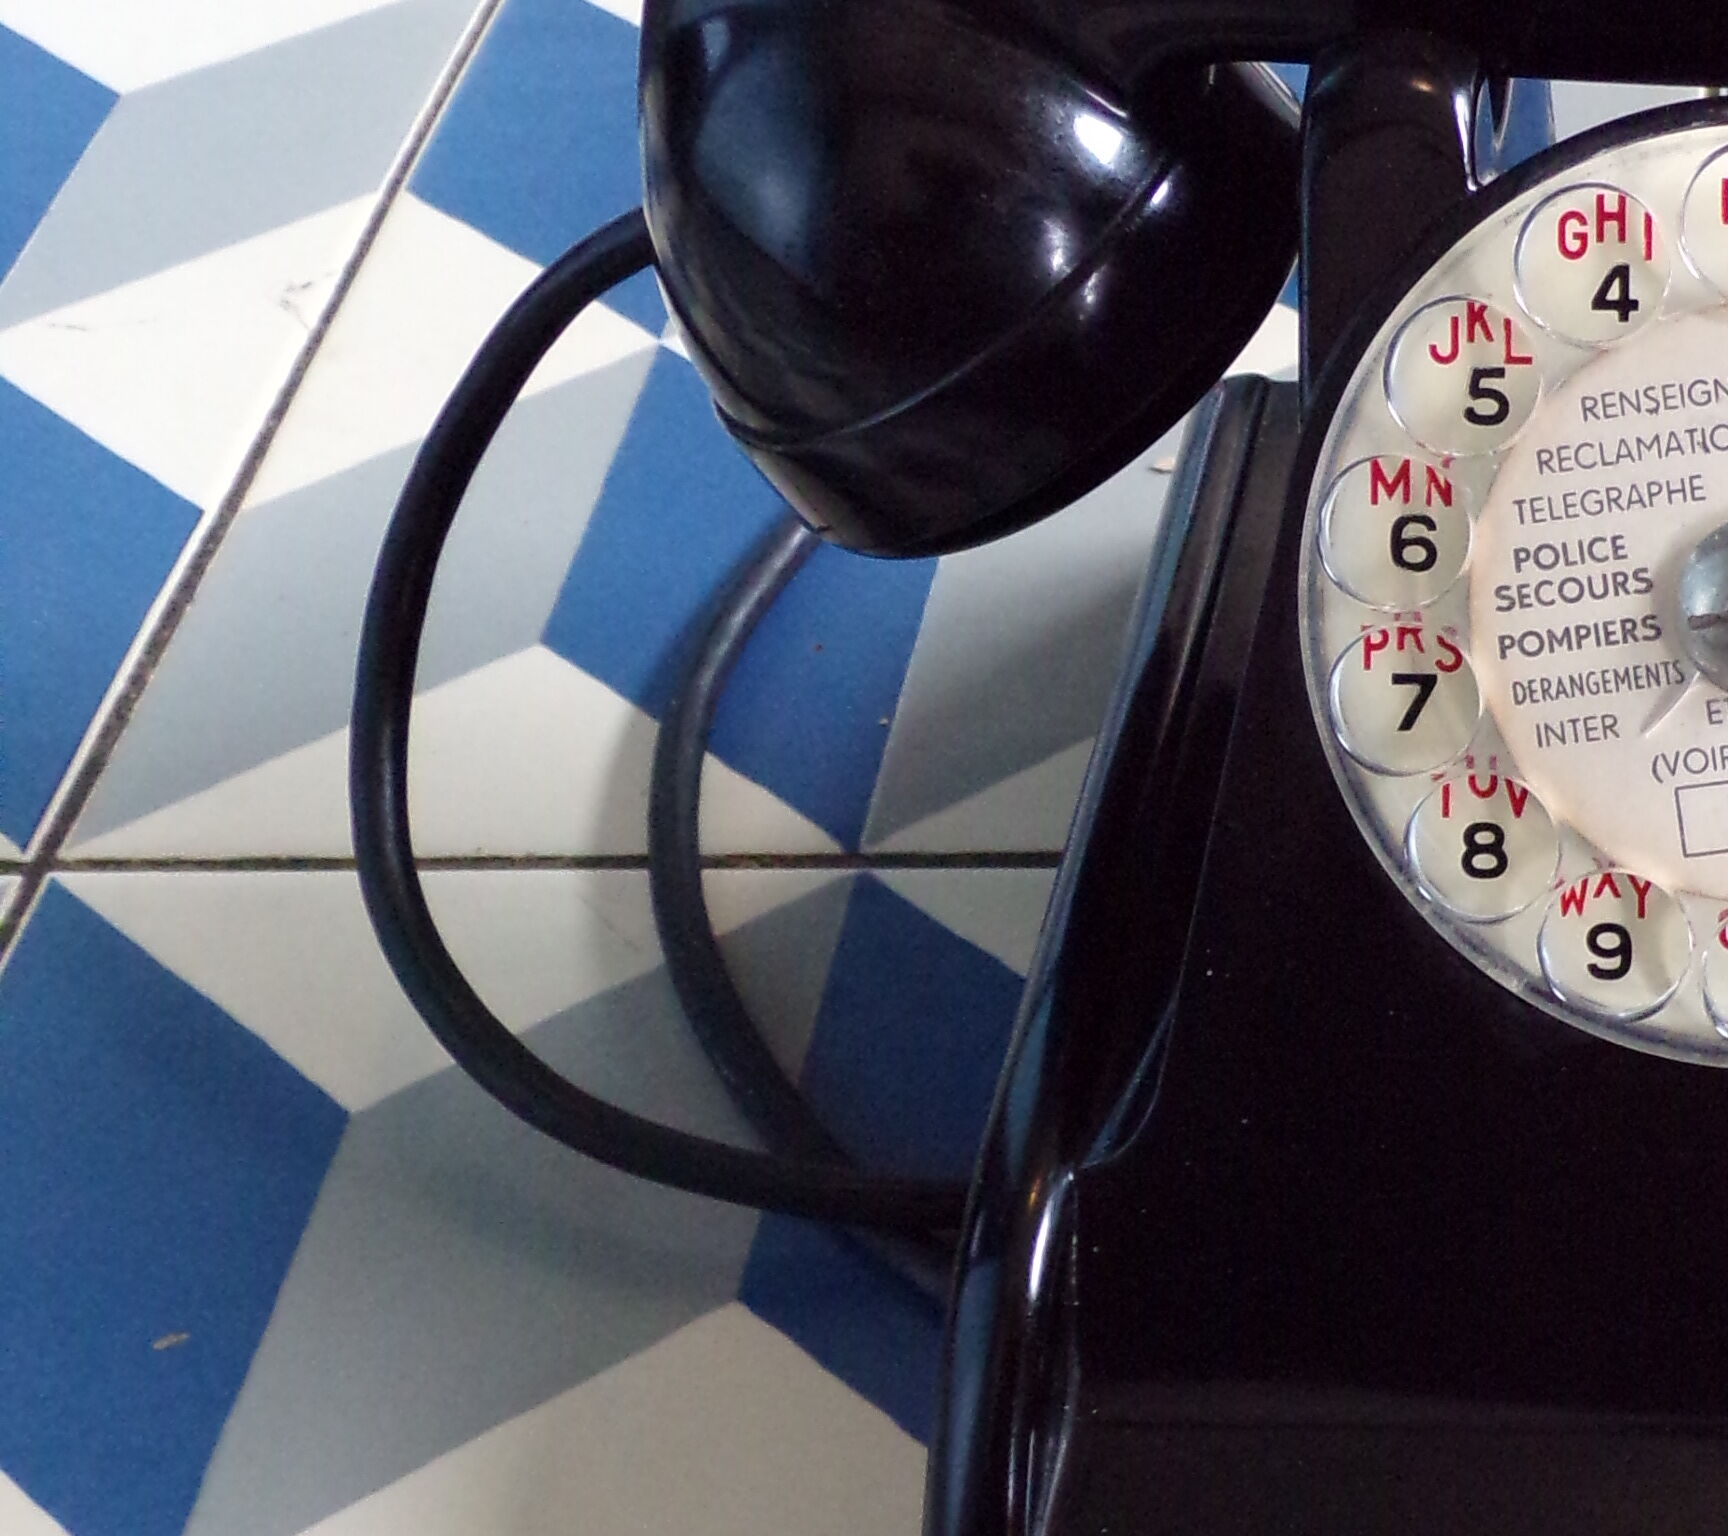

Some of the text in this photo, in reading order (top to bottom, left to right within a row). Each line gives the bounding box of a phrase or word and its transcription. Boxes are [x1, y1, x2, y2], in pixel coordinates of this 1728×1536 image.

[1558, 193, 1653, 261] GHI
[1591, 264, 1639, 323] 4
[1428, 300, 1533, 365] JKL
[1463, 367, 1510, 426] 5
[1369, 458, 1453, 507] MN
[1512, 474, 1706, 525] TELEGRAPHE
[1390, 515, 1438, 574] 6
[1513, 534, 1629, 573] POLICE
[1495, 567, 1654, 613] SECOURS
[1498, 614, 1663, 660] POMPIERS
[1391, 673, 1438, 732] 7
[1512, 659, 1686, 707] DERANGEMENTS
[1535, 713, 1621, 749] INTER
[1461, 822, 1509, 879] 8
[1586, 923, 1633, 980] 9
